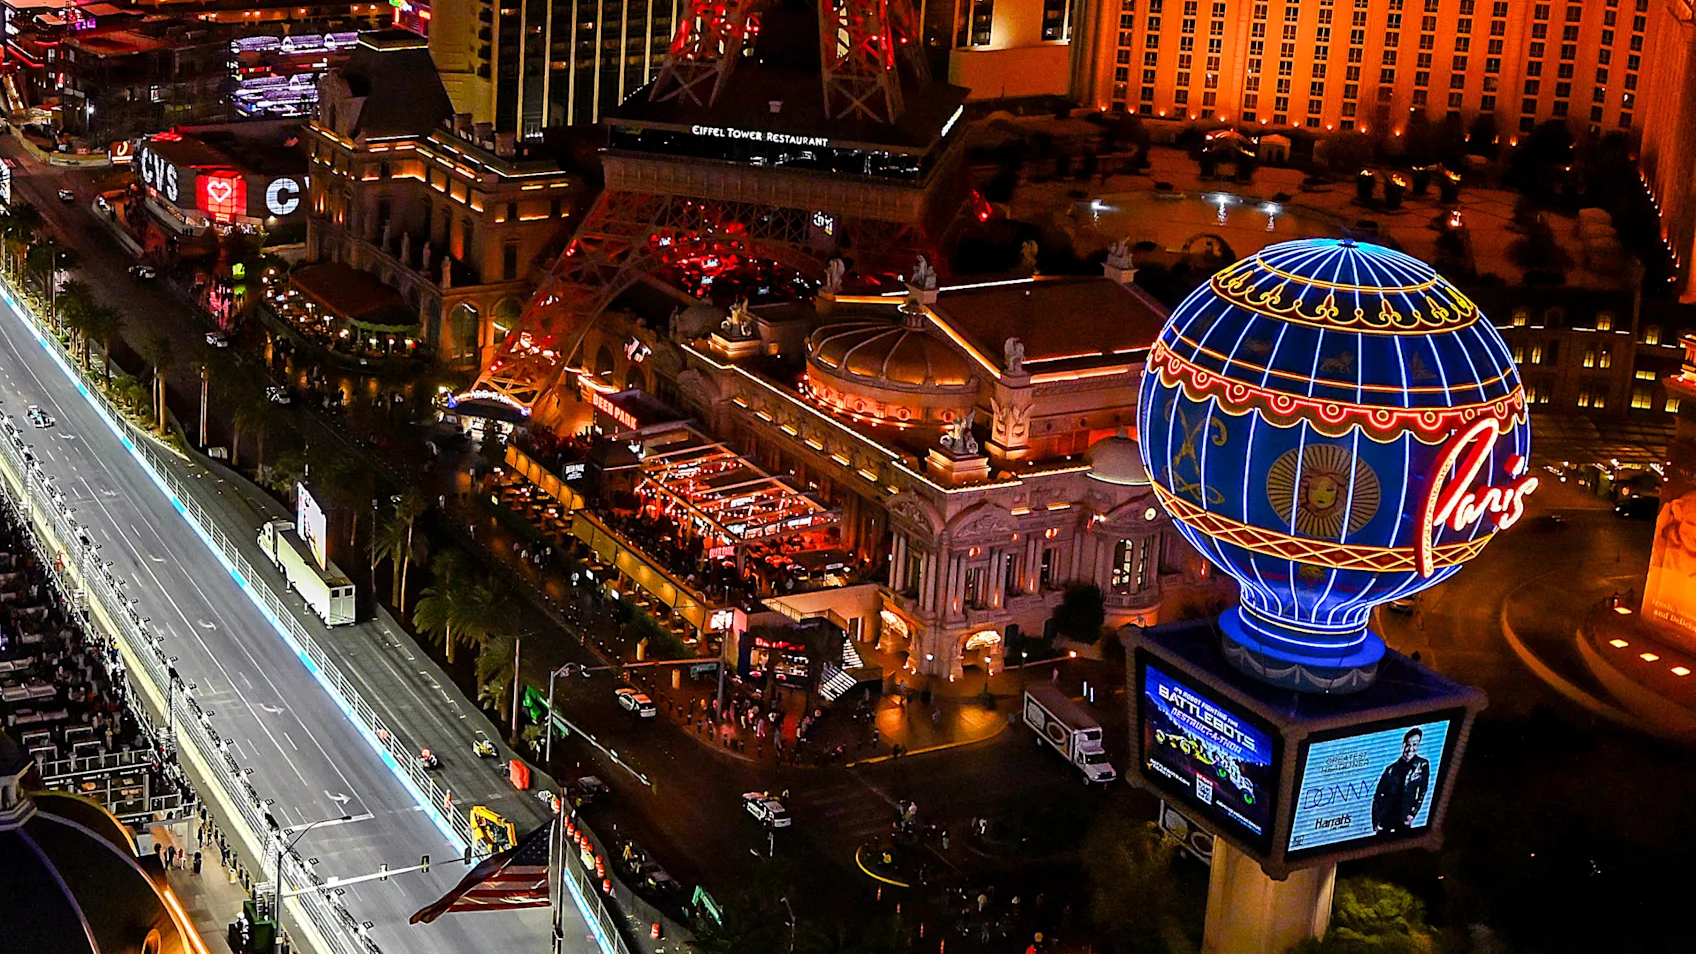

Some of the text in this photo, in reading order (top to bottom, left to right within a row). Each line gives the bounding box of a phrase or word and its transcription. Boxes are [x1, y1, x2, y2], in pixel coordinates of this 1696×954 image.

[691, 125, 829, 147] EIFFEL TOWER RESTAURANT
[141, 146, 179, 202] CVS
[592, 393, 639, 431] BEER PARK
[1420, 417, 1539, 578] Paris
[1653, 609, 1669, 620] and
[1158, 683, 1257, 753] BATTLEBOTS
[1182, 690, 1202, 706] ROBOT
[1201, 702, 1228, 721] FIGHTING
[1170, 707, 1243, 754] DESTRUCT-A-THON
[1304, 777, 1378, 810] DONNY
